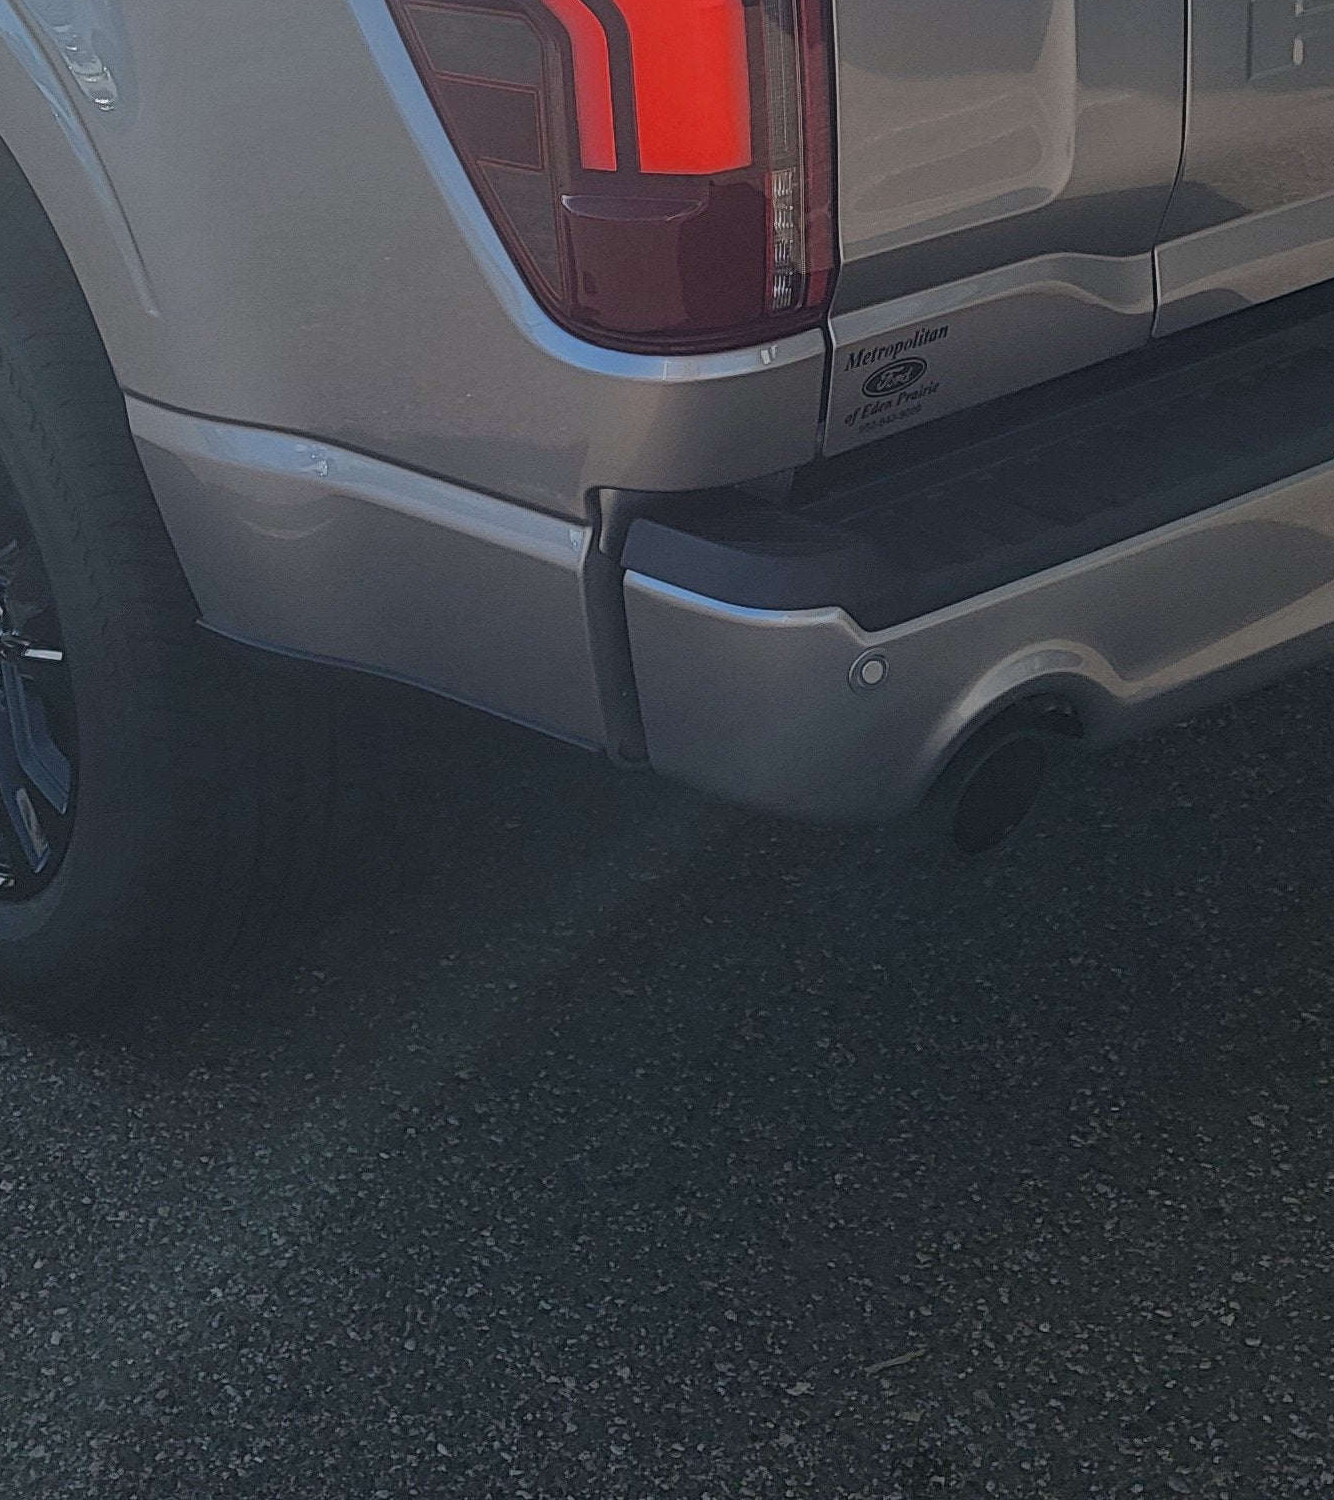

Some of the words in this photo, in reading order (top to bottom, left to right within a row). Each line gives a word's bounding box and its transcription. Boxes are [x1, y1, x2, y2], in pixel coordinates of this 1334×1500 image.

[845, 325, 948, 371] Metropolitan
[844, 408, 861, 426] of
[861, 401, 892, 419] Eden
[897, 382, 939, 406] Prairie
